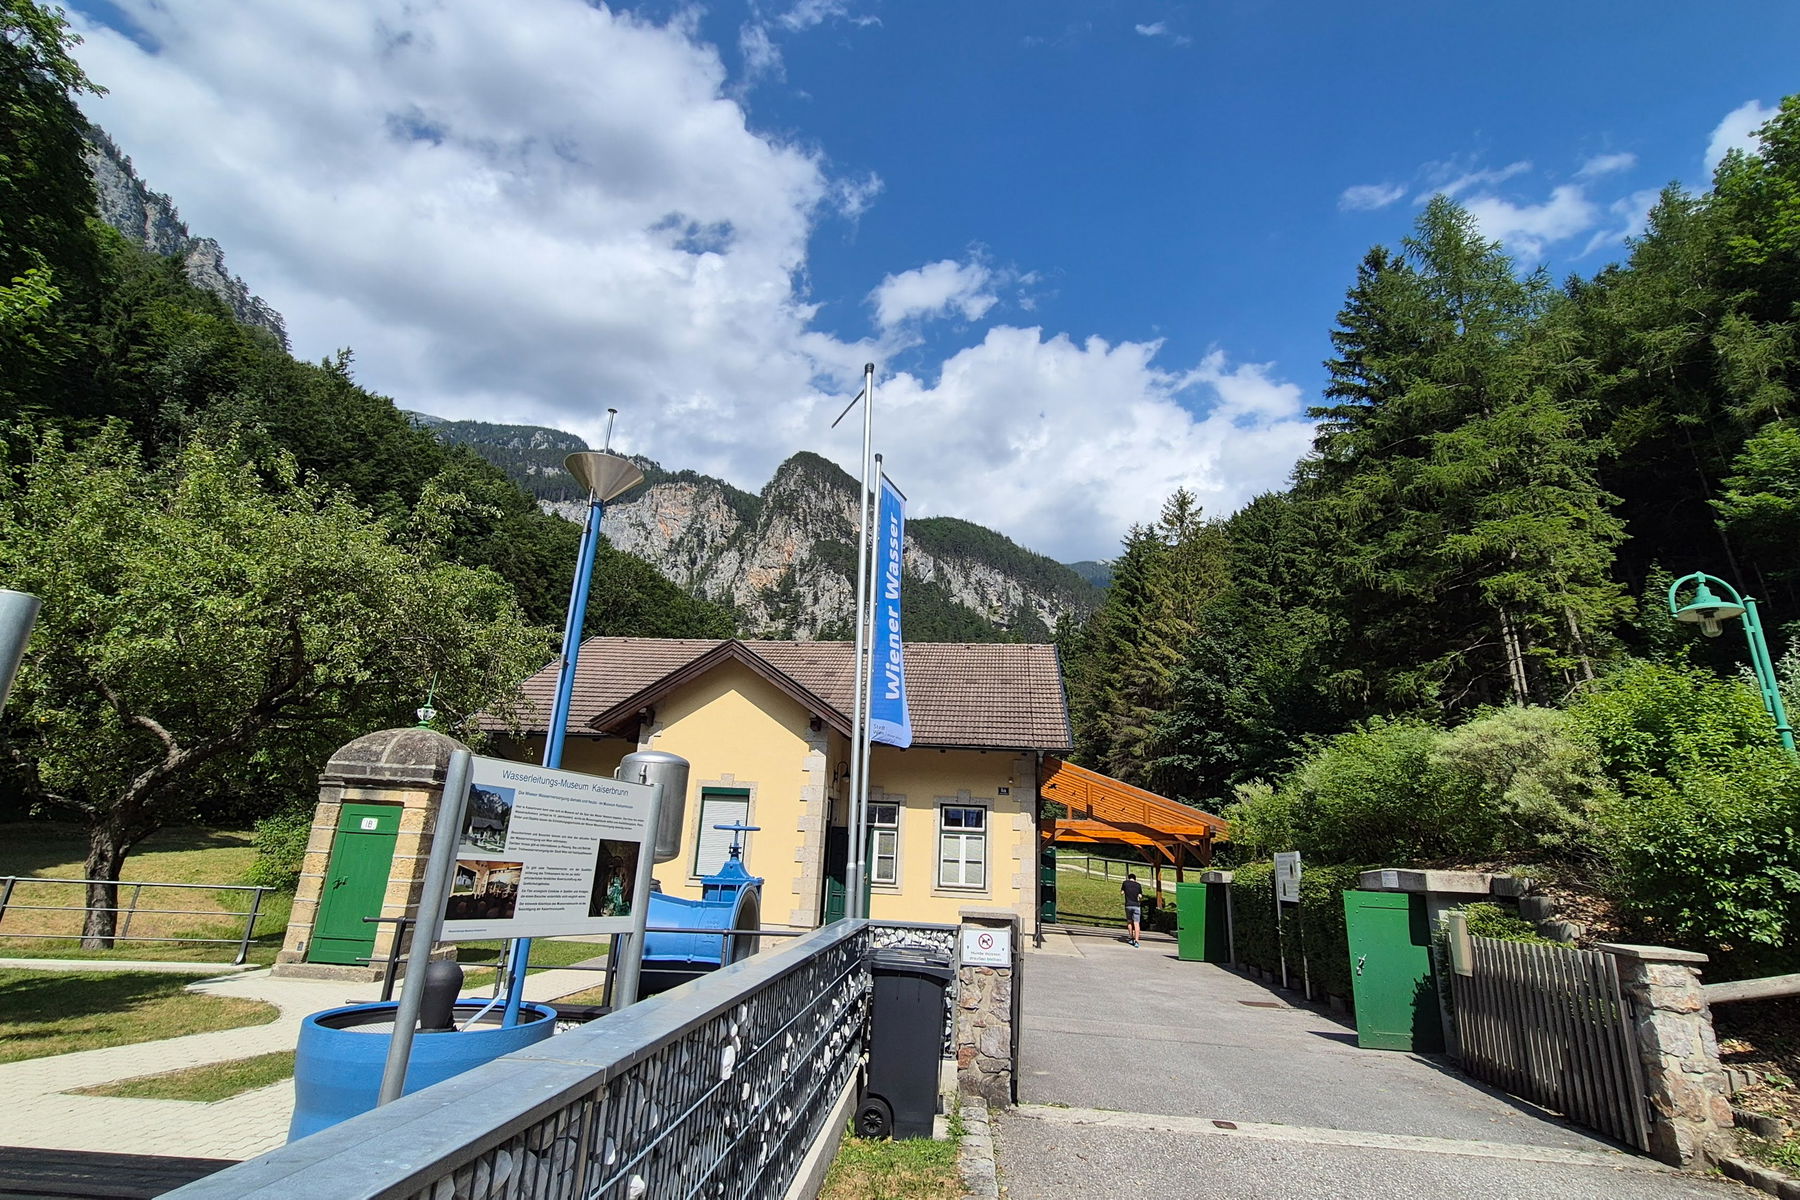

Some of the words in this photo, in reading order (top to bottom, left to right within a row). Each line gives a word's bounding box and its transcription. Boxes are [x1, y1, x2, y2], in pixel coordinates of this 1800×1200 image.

[885, 511, 899, 600] Wasser
[885, 605, 900, 700] Wiener
[502, 769, 589, 791] Wasserleitungs-Museum
[591, 783, 630, 797] Kaiserbrunn
